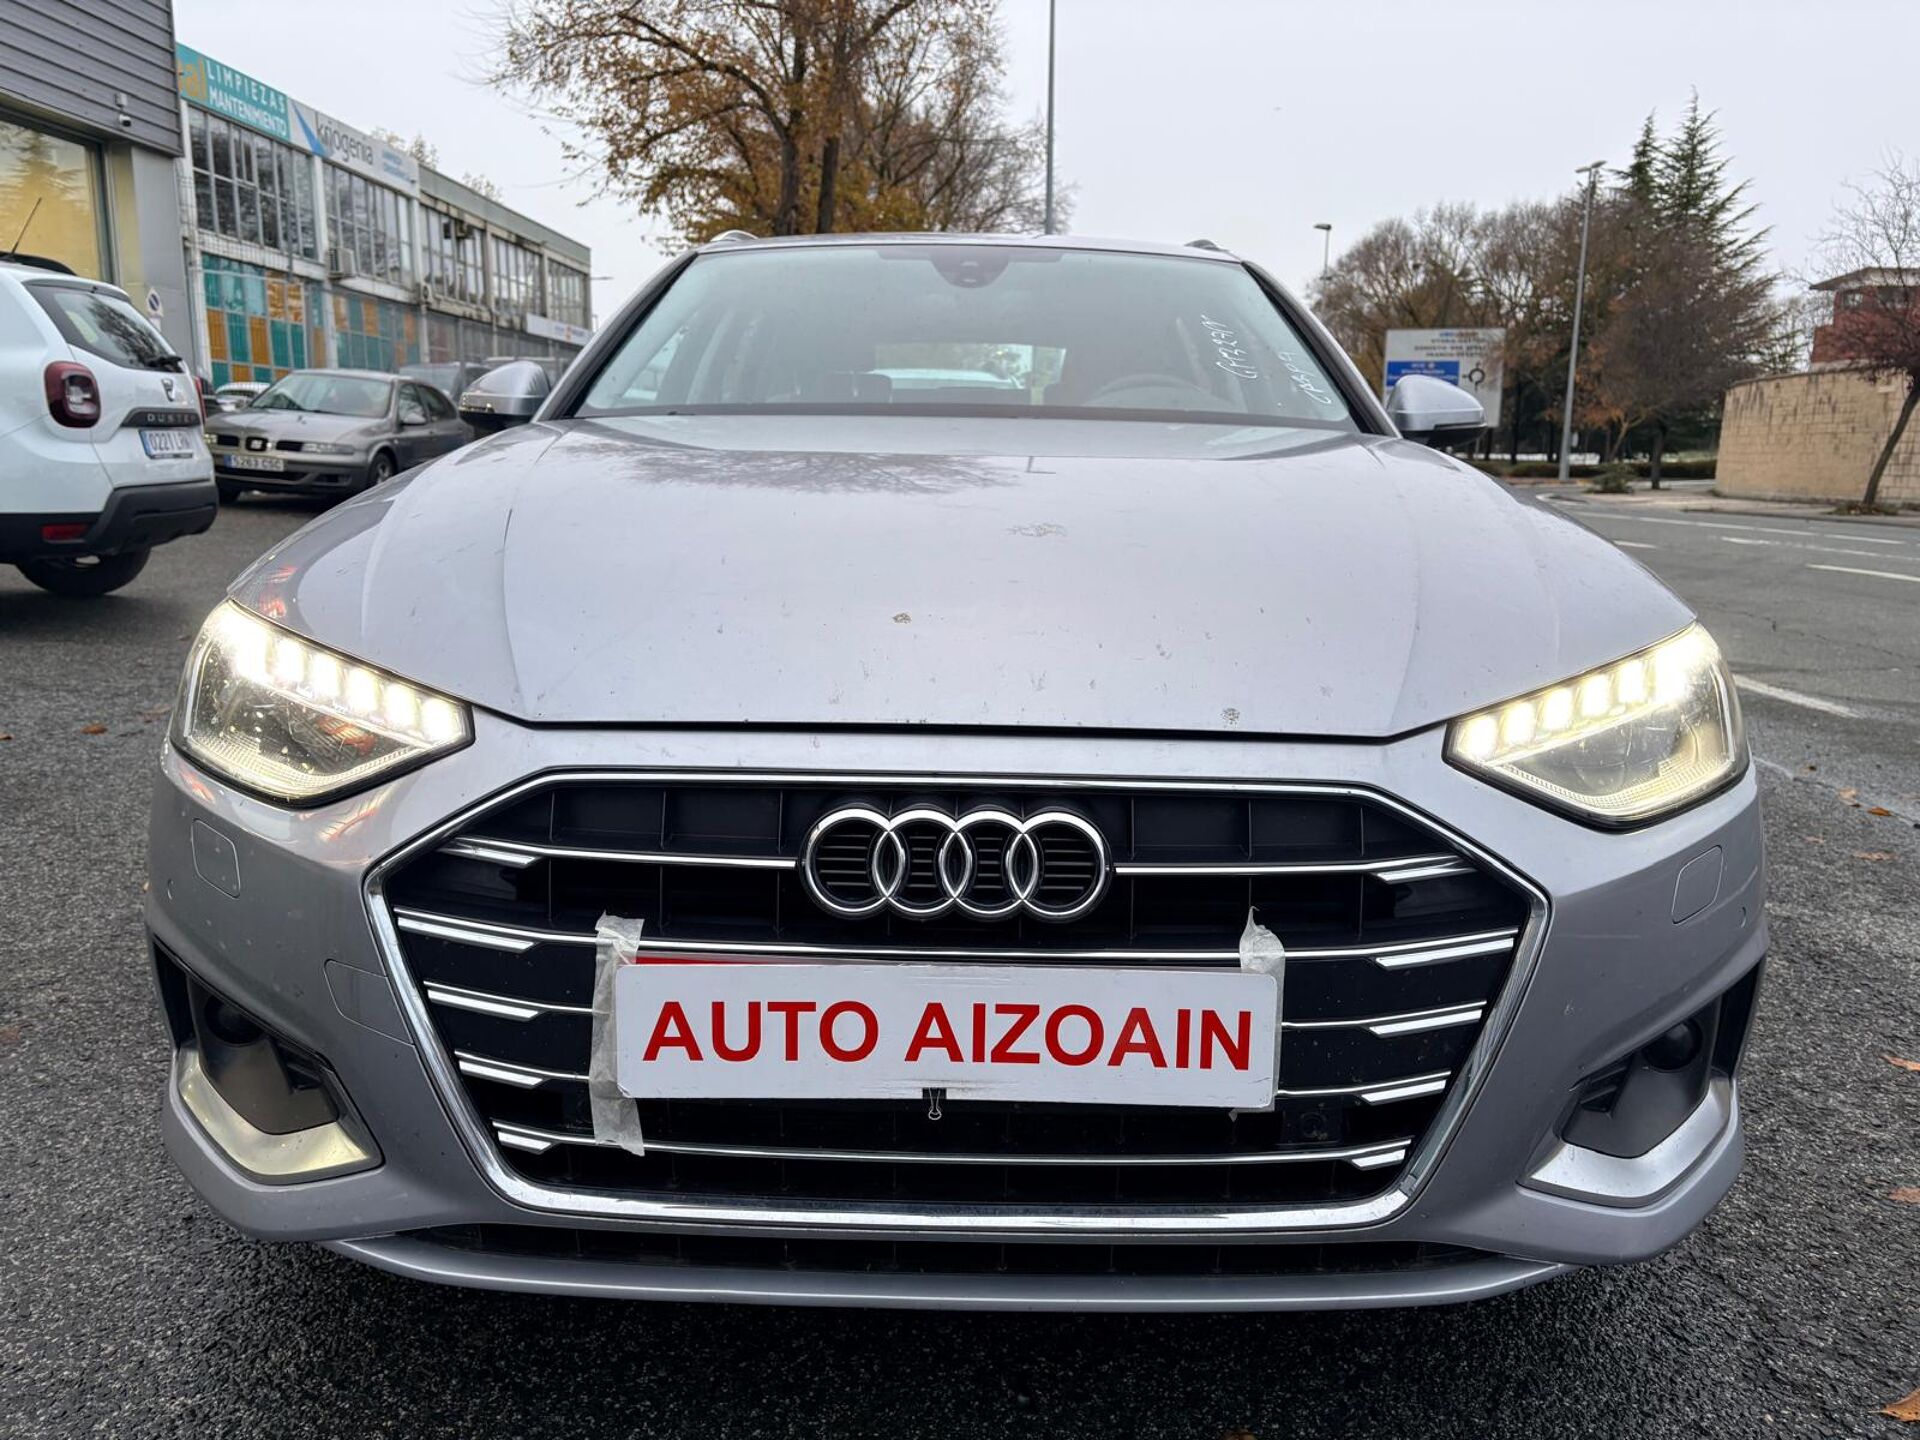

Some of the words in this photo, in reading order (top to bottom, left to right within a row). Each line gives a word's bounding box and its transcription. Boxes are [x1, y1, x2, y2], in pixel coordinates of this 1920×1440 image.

[206, 59, 286, 114] LIMPIEZAS
[208, 85, 287, 137] MANTENIMIENTO
[642, 1000, 879, 1063] AUTO
[904, 1002, 1252, 1071] AIZOAIN
